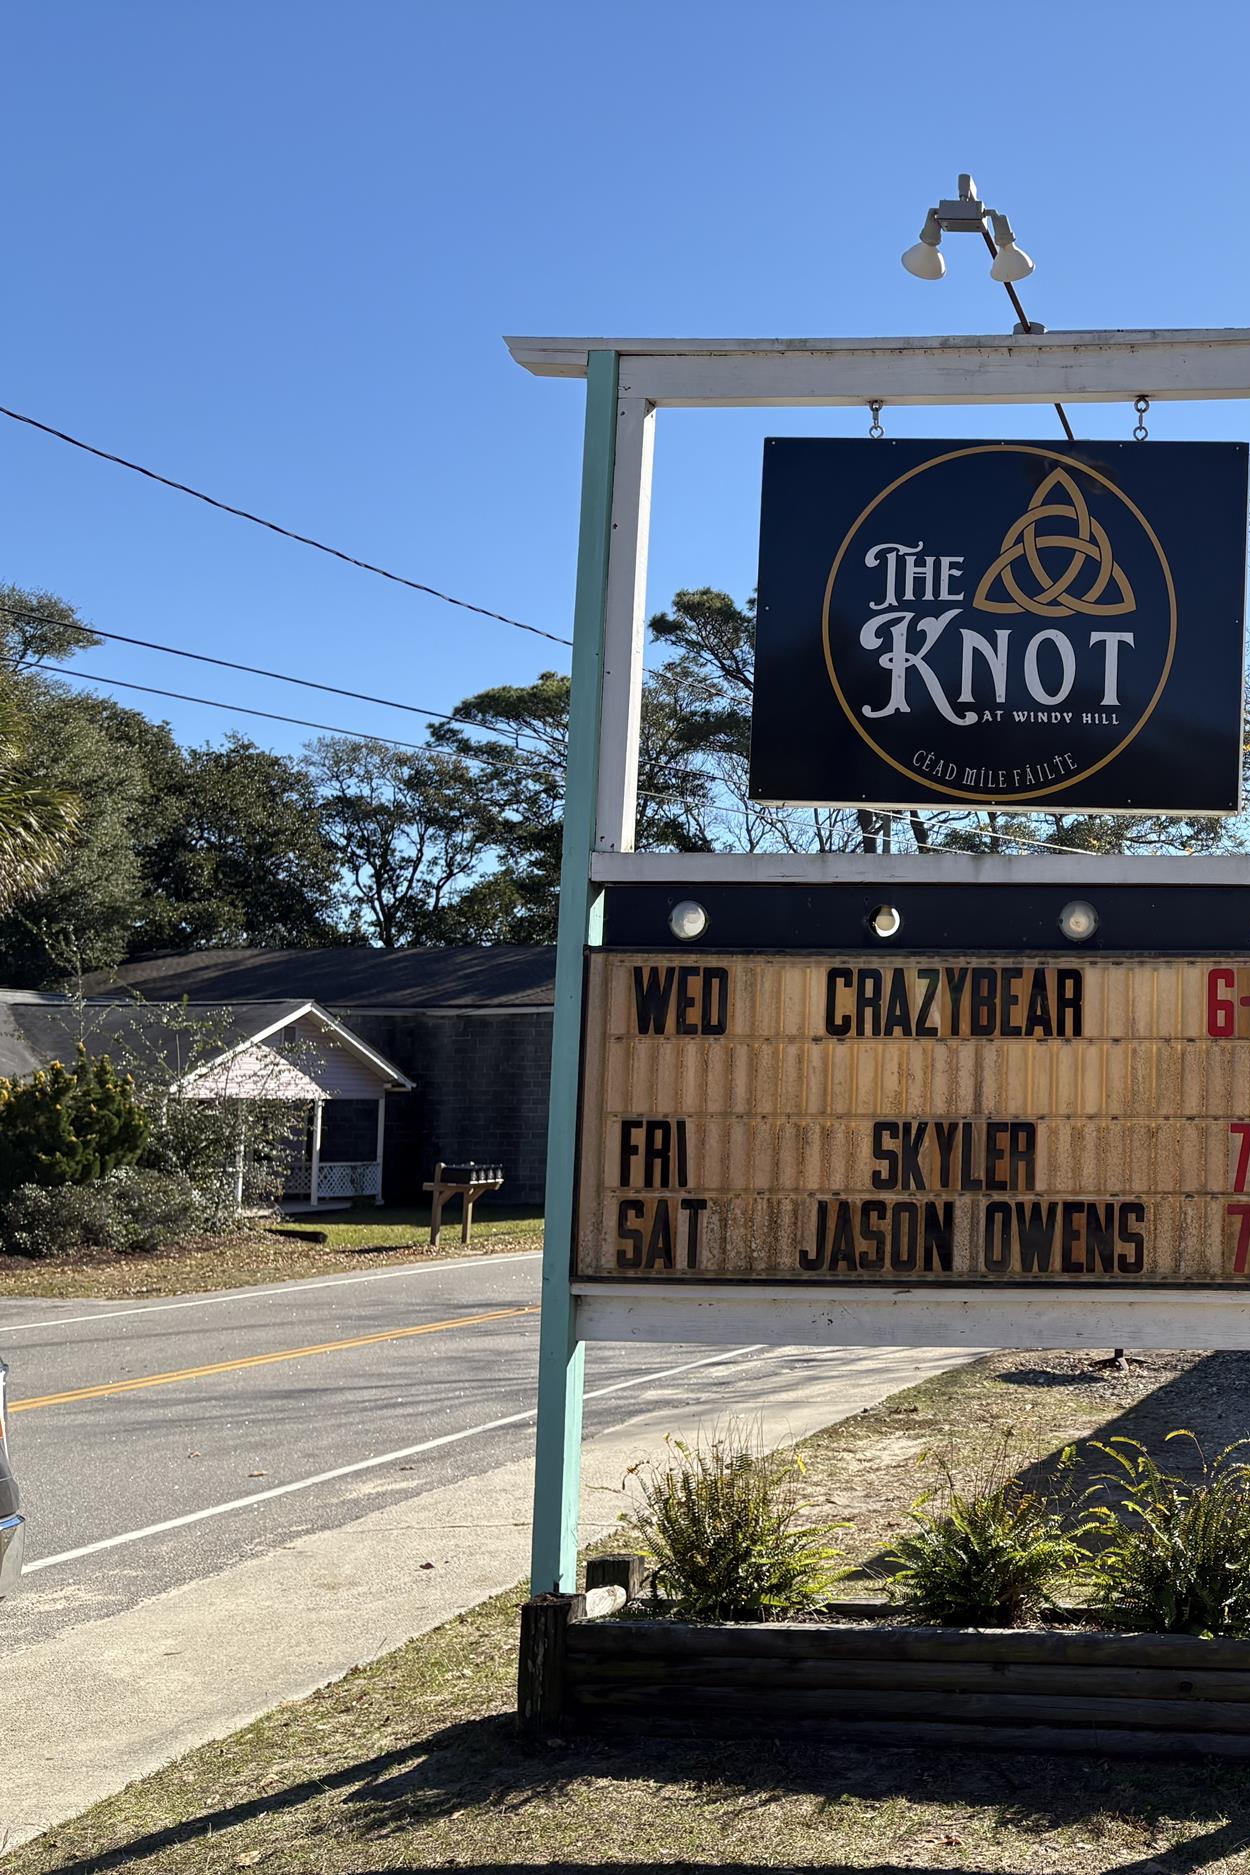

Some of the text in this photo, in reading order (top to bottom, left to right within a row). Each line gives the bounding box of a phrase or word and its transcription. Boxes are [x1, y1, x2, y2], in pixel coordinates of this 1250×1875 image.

[864, 541, 965, 610] THE
[859, 608, 1136, 726] KNOT
[981, 710, 1119, 725] AT WINDY HILL
[633, 966, 729, 1035] WED
[826, 967, 1083, 1037] CRAZYBEAR
[620, 1119, 688, 1188] FRI
[872, 1121, 1036, 1192] SKYLER
[616, 1199, 708, 1269] SAT
[799, 1200, 954, 1272] JASON
[984, 1201, 1146, 1274] OWENS
